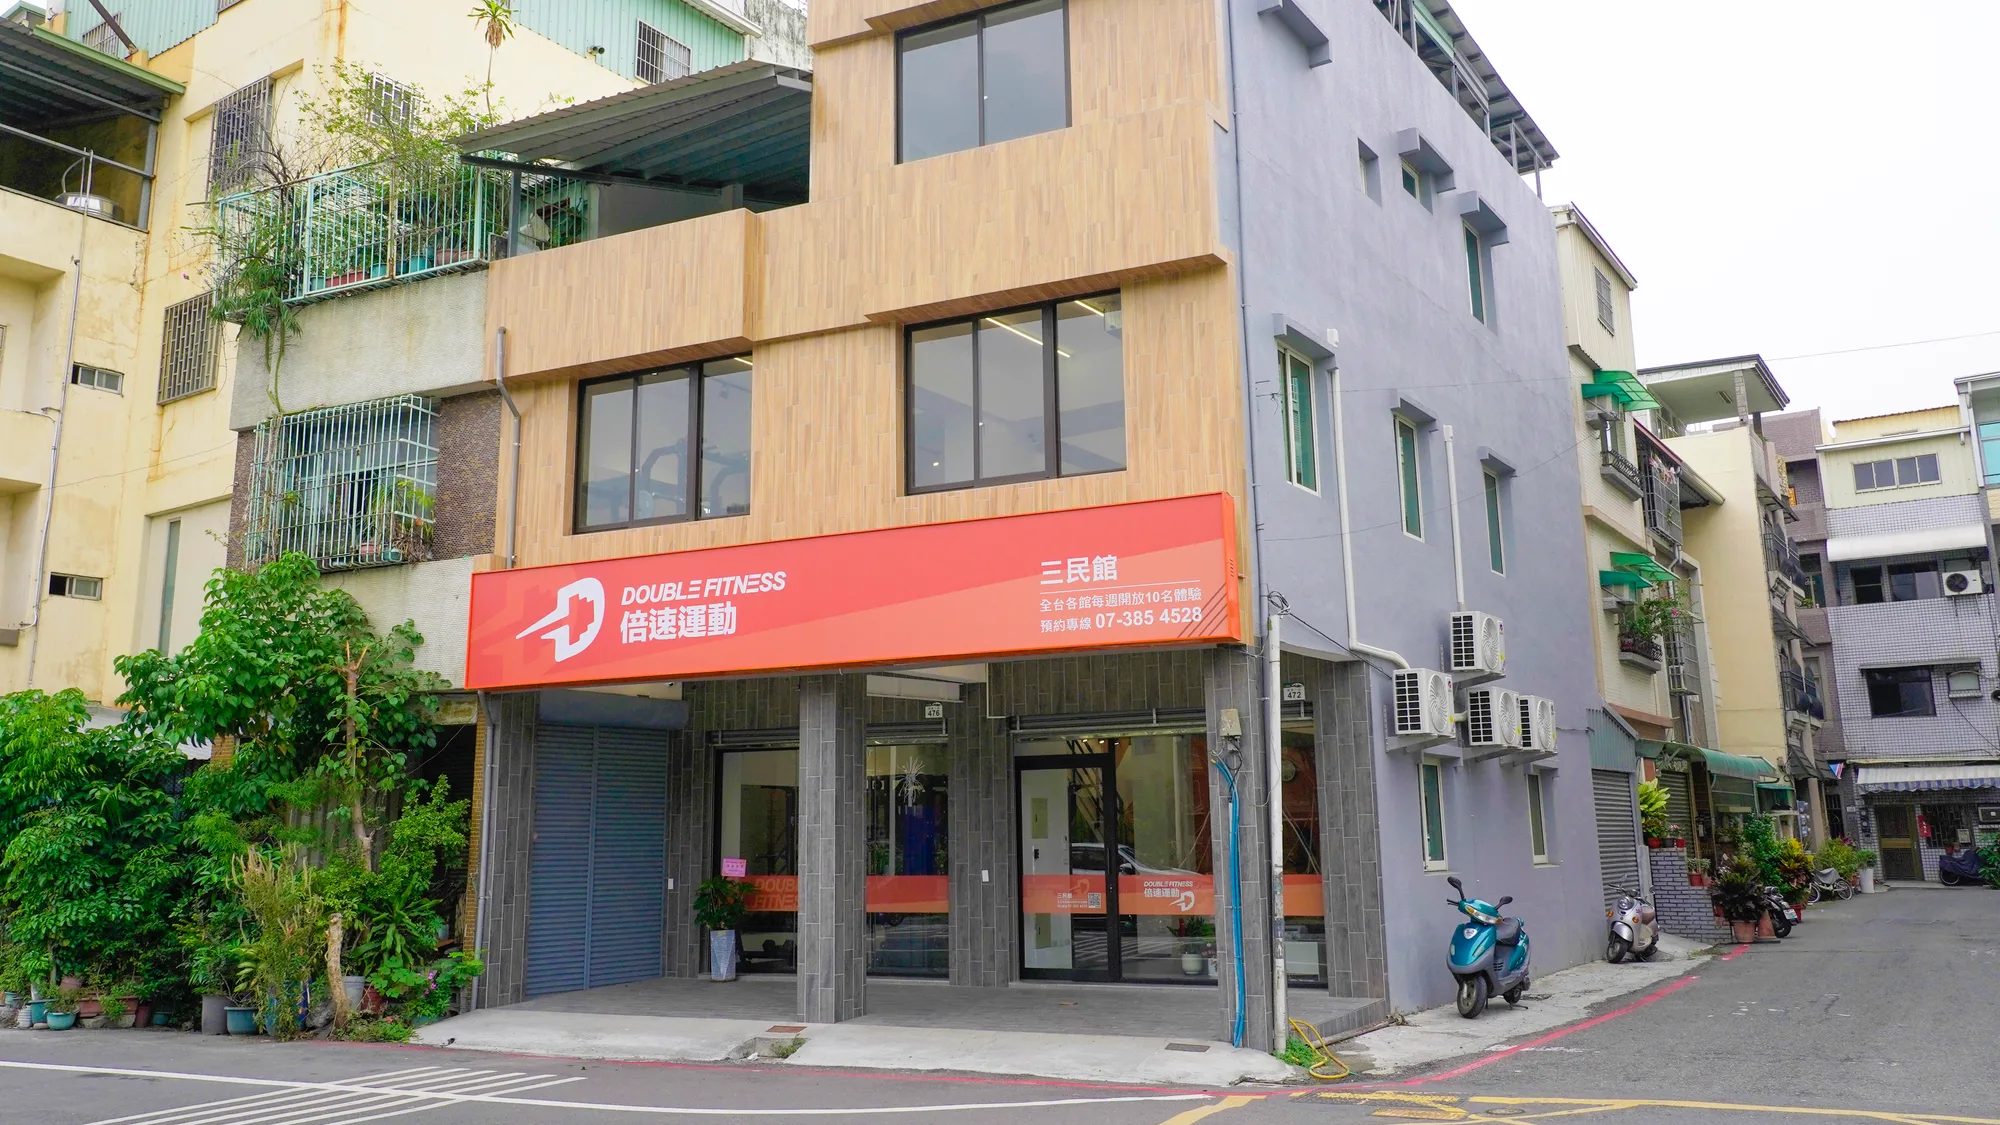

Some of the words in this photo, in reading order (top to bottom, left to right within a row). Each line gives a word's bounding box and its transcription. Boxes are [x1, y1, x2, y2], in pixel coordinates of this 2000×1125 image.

[1041, 555, 1117, 584] 三民館
[621, 580, 702, 605] DOUBLE
[704, 571, 787, 598] FITNESS
[1039, 587, 1202, 612] 全台各館每週開放10名體驗
[620, 601, 736, 643] 倍速運動
[1040, 616, 1092, 633] 預約專線
[1095, 610, 1154, 629] 07-385
[1159, 607, 1202, 624] 4528
[1144, 888, 1180, 898] 倍速運動
